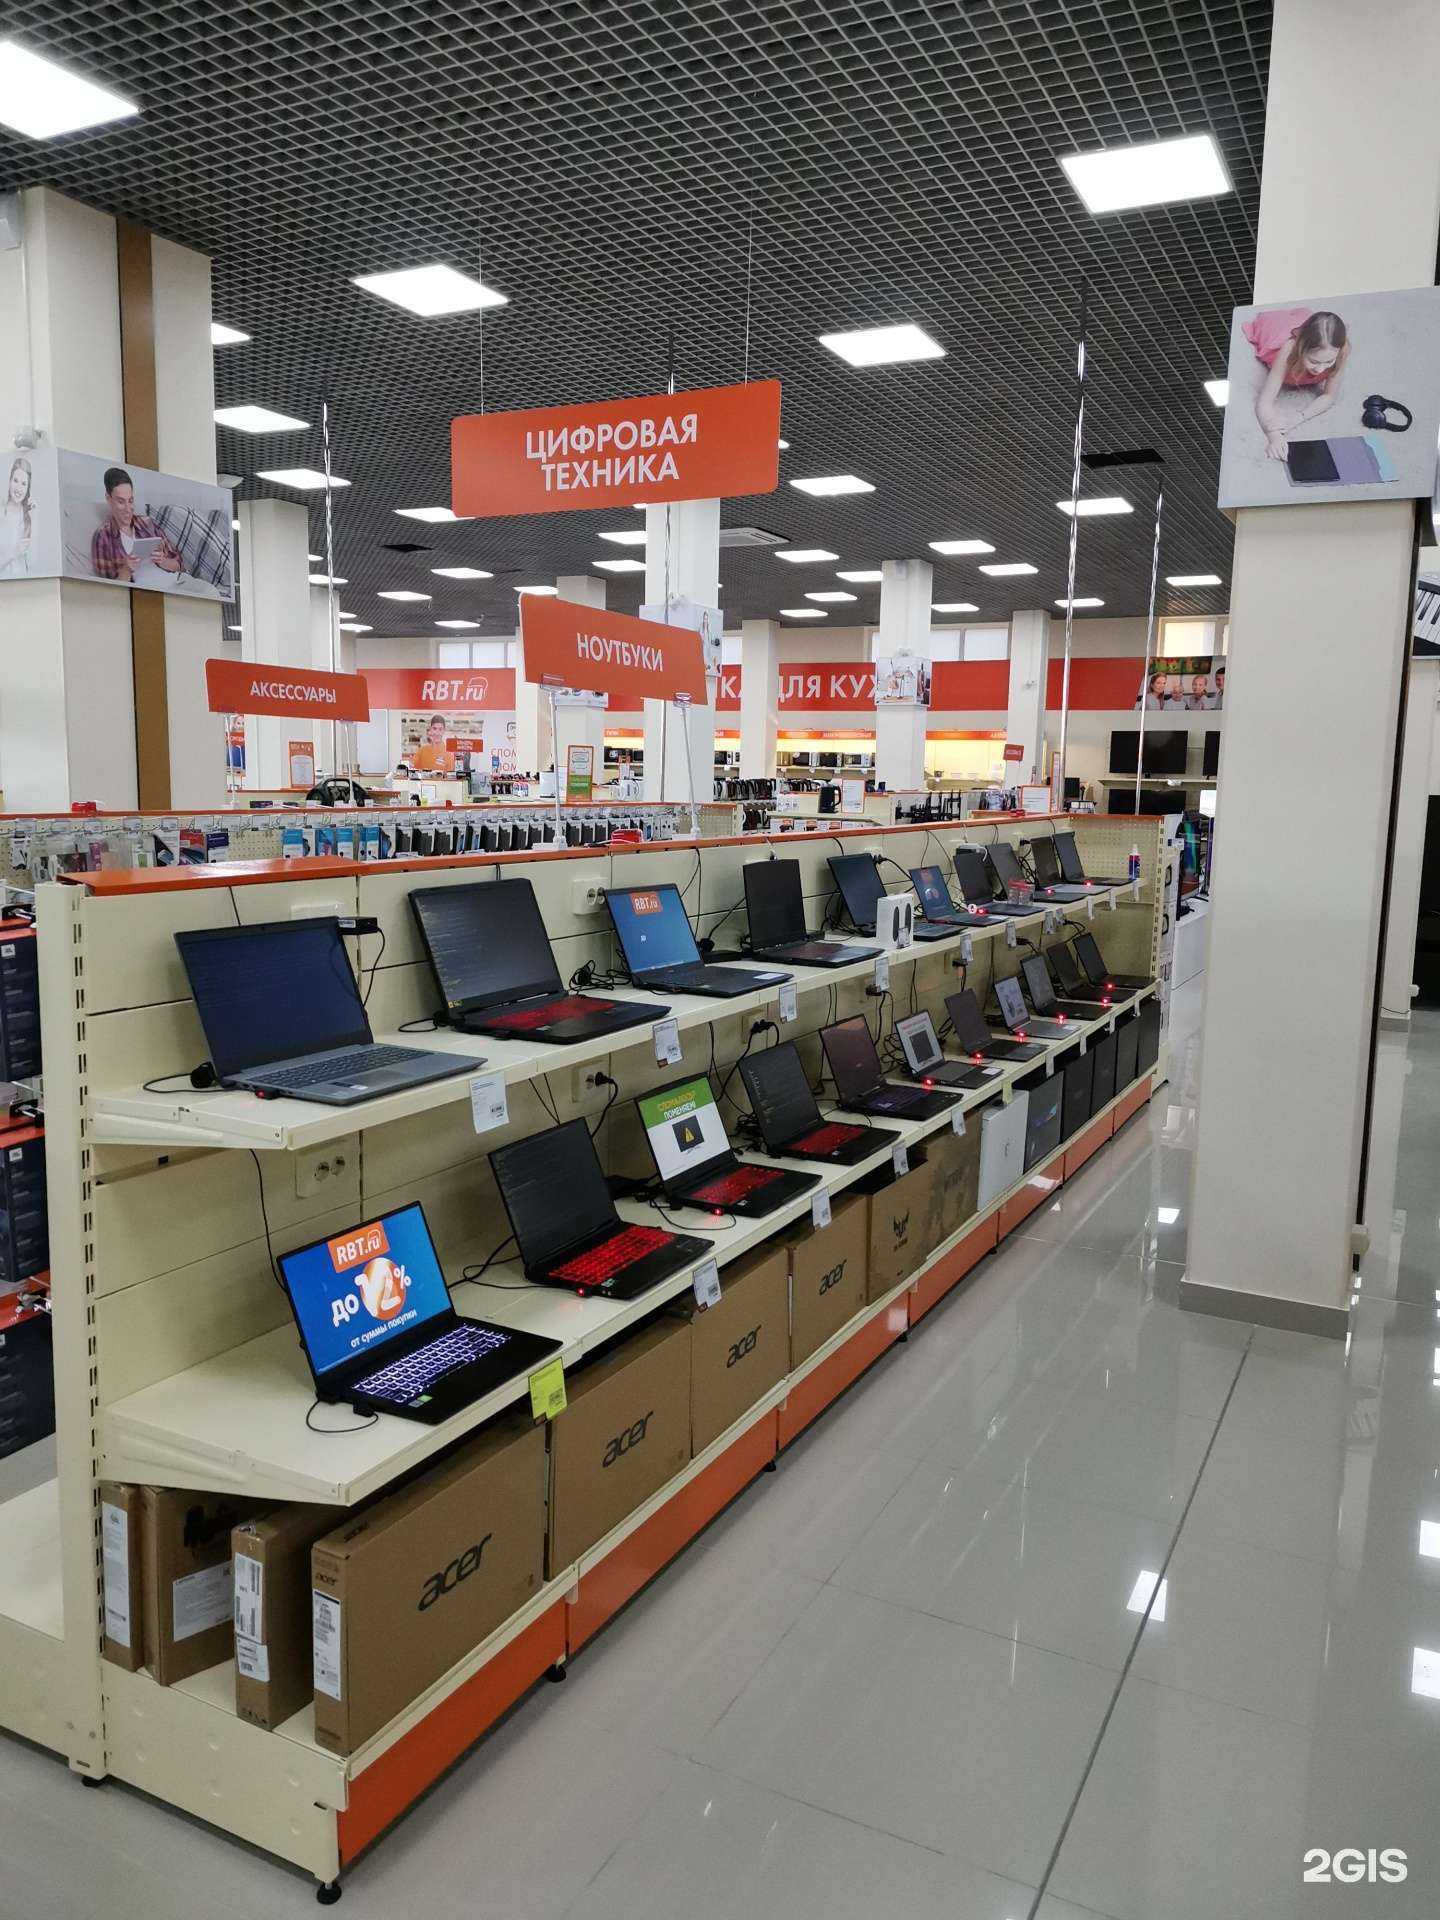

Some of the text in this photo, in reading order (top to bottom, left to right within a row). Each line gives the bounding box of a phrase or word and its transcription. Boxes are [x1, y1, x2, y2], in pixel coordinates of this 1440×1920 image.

[526, 413, 698, 463] ЦИФРОВАЯ
[541, 452, 680, 491] ТЕХНИКА
[576, 632, 663, 672] НОУТБУКИ
[250, 680, 337, 703] АКСЕССУАРЫ
[421, 678, 485, 701] RBT.ru
[634, 896, 658, 911] RBT.ru
[336, 1234, 380, 1266] RBT.ru
[819, 1258, 848, 1296] acer
[361, 1324, 388, 1343] суммы
[387, 1309, 418, 1331] покупки
[726, 1324, 762, 1369] acer
[602, 1410, 654, 1469] acer
[416, 1531, 493, 1612] acer
